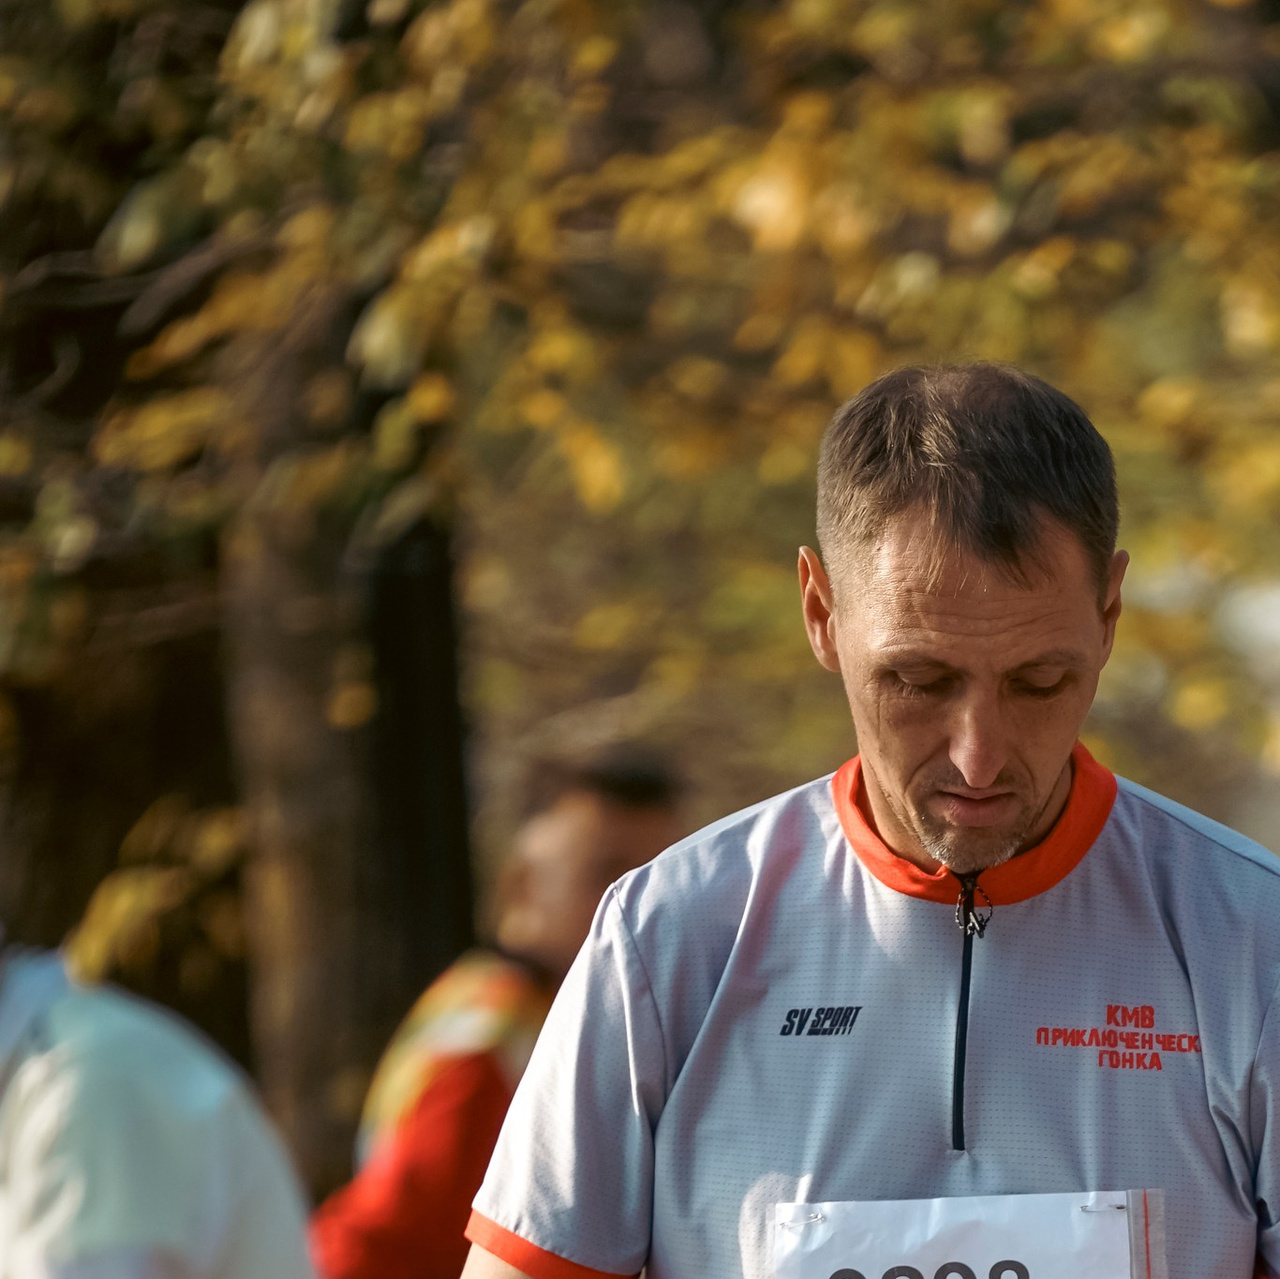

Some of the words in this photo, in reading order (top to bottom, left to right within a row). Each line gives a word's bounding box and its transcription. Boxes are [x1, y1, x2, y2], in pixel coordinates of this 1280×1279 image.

[780, 1009, 812, 1036] SV
[810, 1006, 863, 1035] SPORT
[1106, 1003, 1155, 1029] КМВ
[1097, 1050, 1163, 1071] ГОНКА
